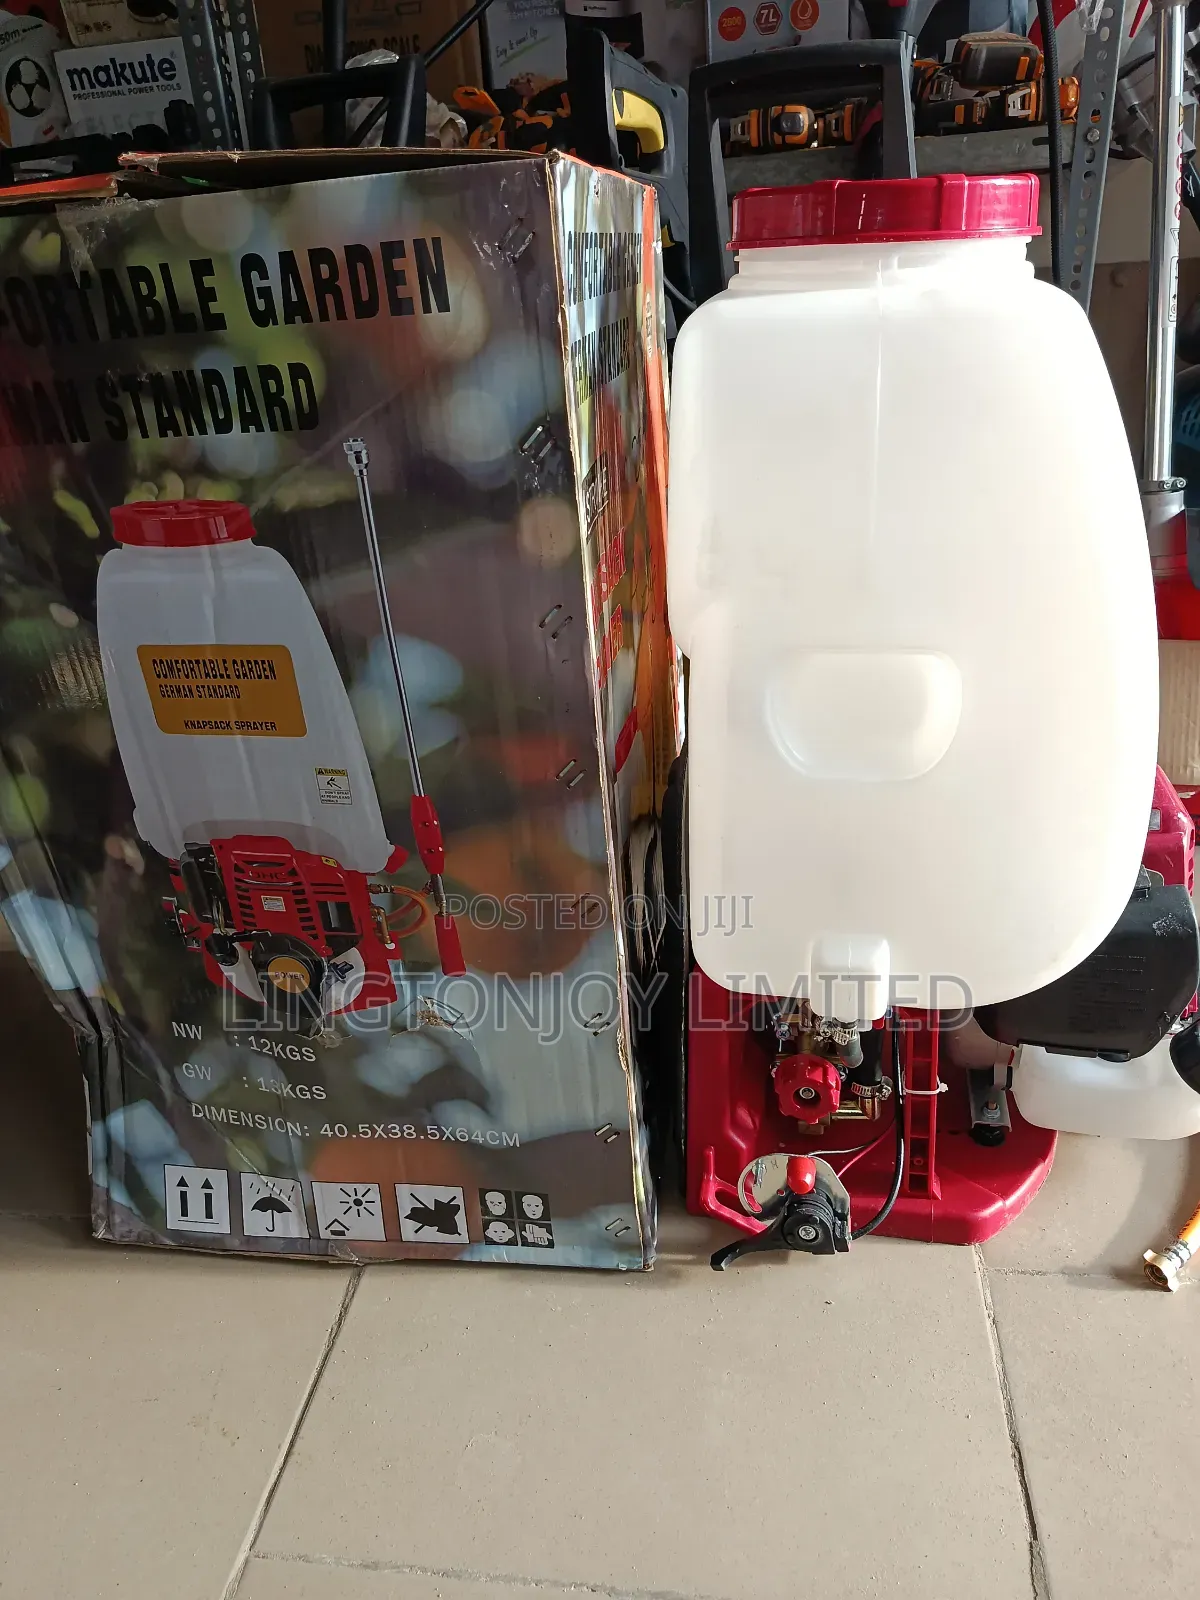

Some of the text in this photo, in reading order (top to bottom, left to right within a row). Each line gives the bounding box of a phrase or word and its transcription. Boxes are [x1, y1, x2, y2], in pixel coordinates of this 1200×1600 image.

[760, 9, 777, 24] 7L
[66, 54, 177, 91] makute
[73, 83, 182, 101] PROFESSIONAL POWER TOOLS
[0, 236, 451, 347] ORTABLE GARDEN
[100, 362, 319, 442] STANDARD
[152, 658, 277, 680] COMFORTABLE GARDEN
[159, 684, 241, 699] GERMAN STANDARD
[184, 719, 277, 731] KNAPSACK SPRAYER
[274, 970, 305, 981] POWER
[172, 1021, 202, 1041] NW
[249, 1035, 317, 1063] 12KGS
[182, 1062, 212, 1081] GW
[191, 1102, 521, 1149] DIMENSION: 40.5X38.5X64CM
